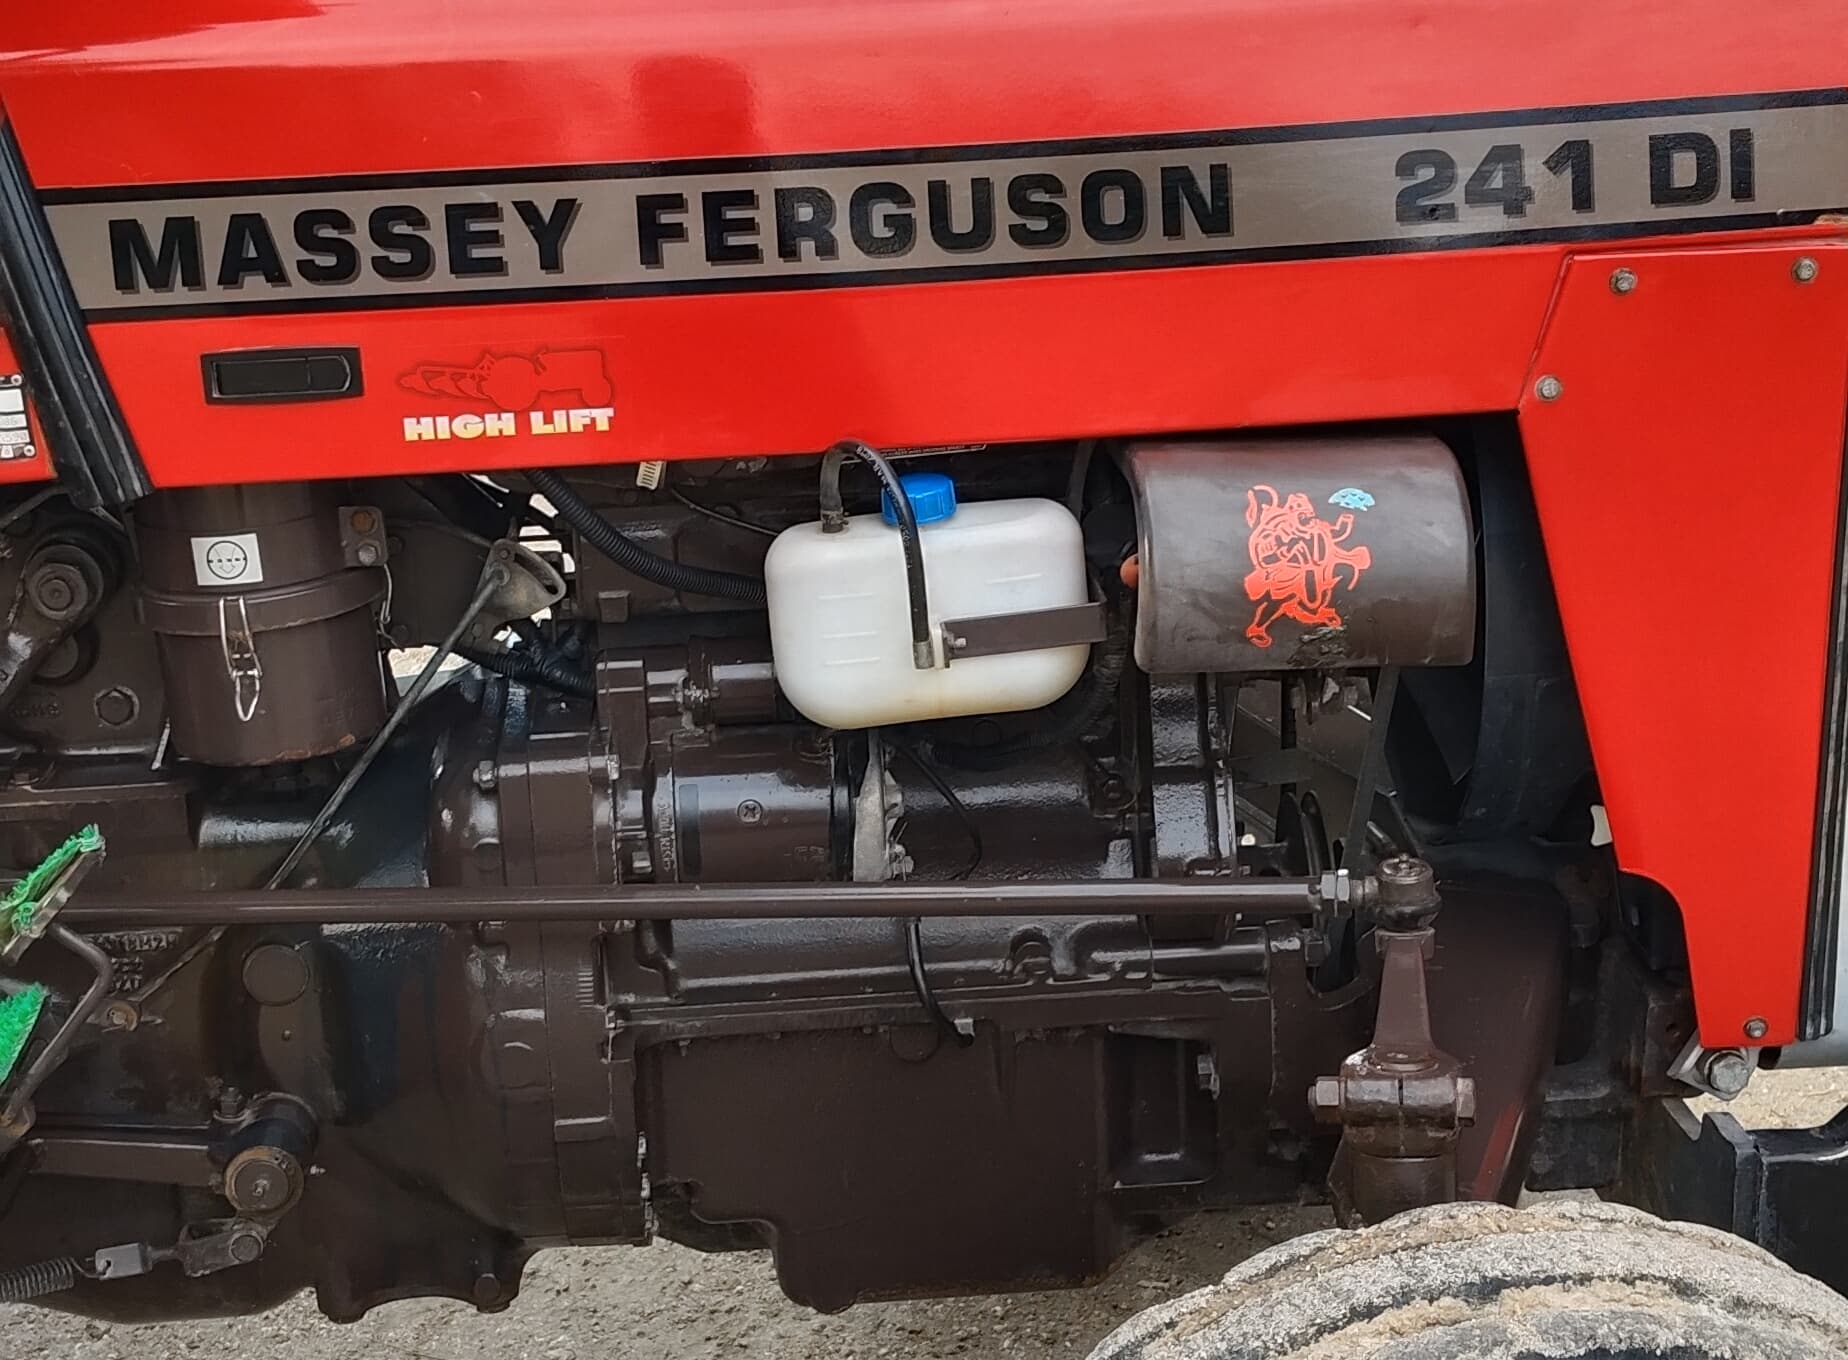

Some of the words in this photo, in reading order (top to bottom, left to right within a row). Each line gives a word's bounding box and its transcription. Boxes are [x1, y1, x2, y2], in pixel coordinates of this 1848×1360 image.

[108, 198, 581, 294] MASSEY
[635, 162, 1235, 270] FERGUSON
[1394, 138, 1596, 223] 241
[1648, 127, 1756, 207] DI
[403, 411, 516, 441] HIGH
[529, 407, 614, 435] LIFT
